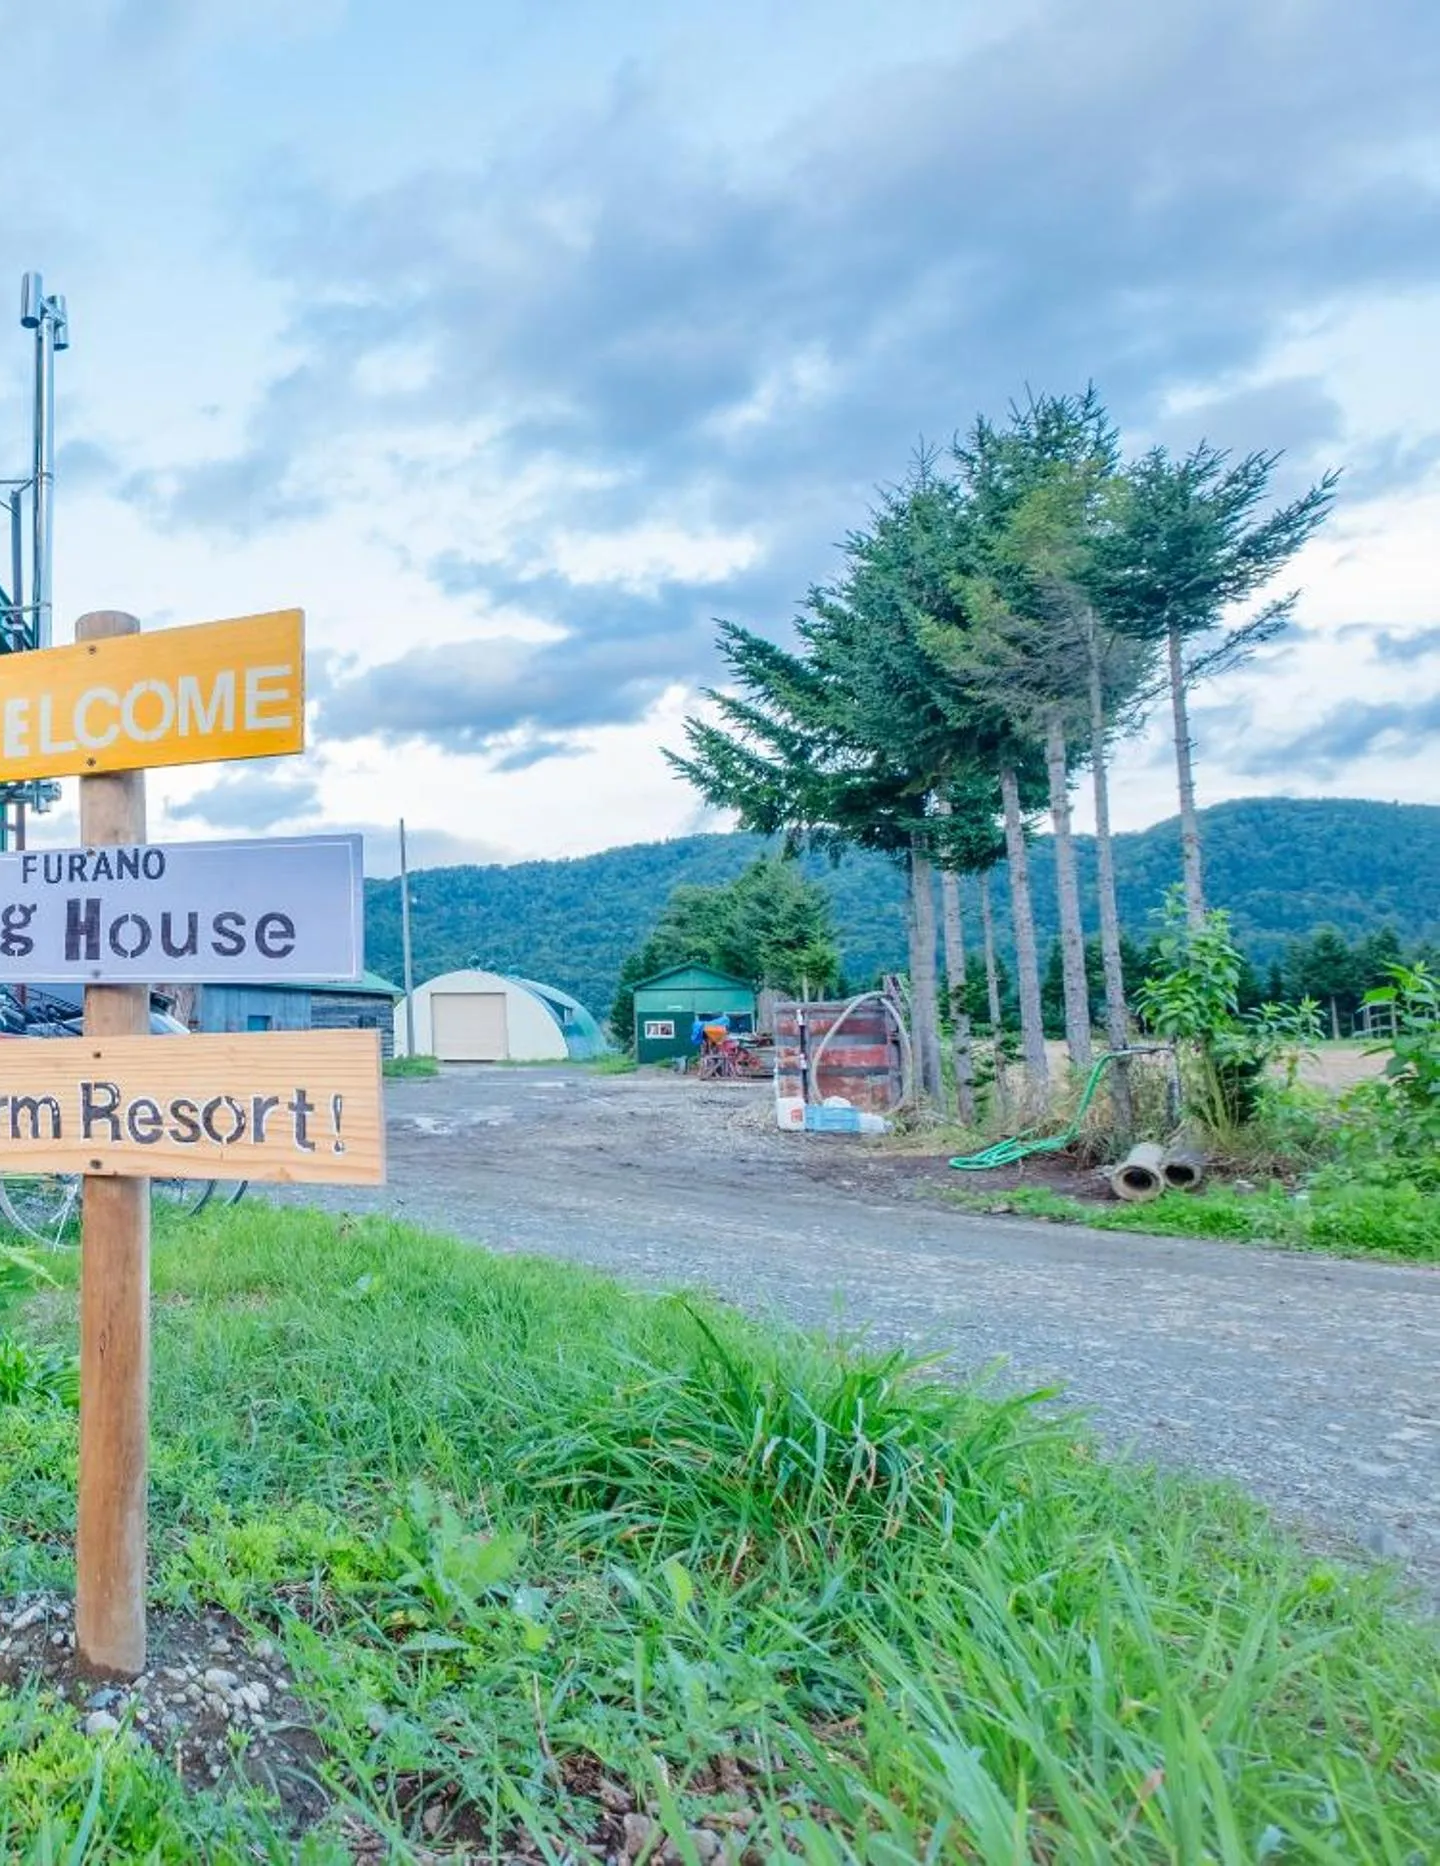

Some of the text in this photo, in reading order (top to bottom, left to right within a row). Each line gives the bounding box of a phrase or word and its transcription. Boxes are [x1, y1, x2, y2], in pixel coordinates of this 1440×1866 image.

[21, 847, 167, 884] FURANO
[64, 897, 296, 961] House
[79, 1082, 346, 1154] Resort!
